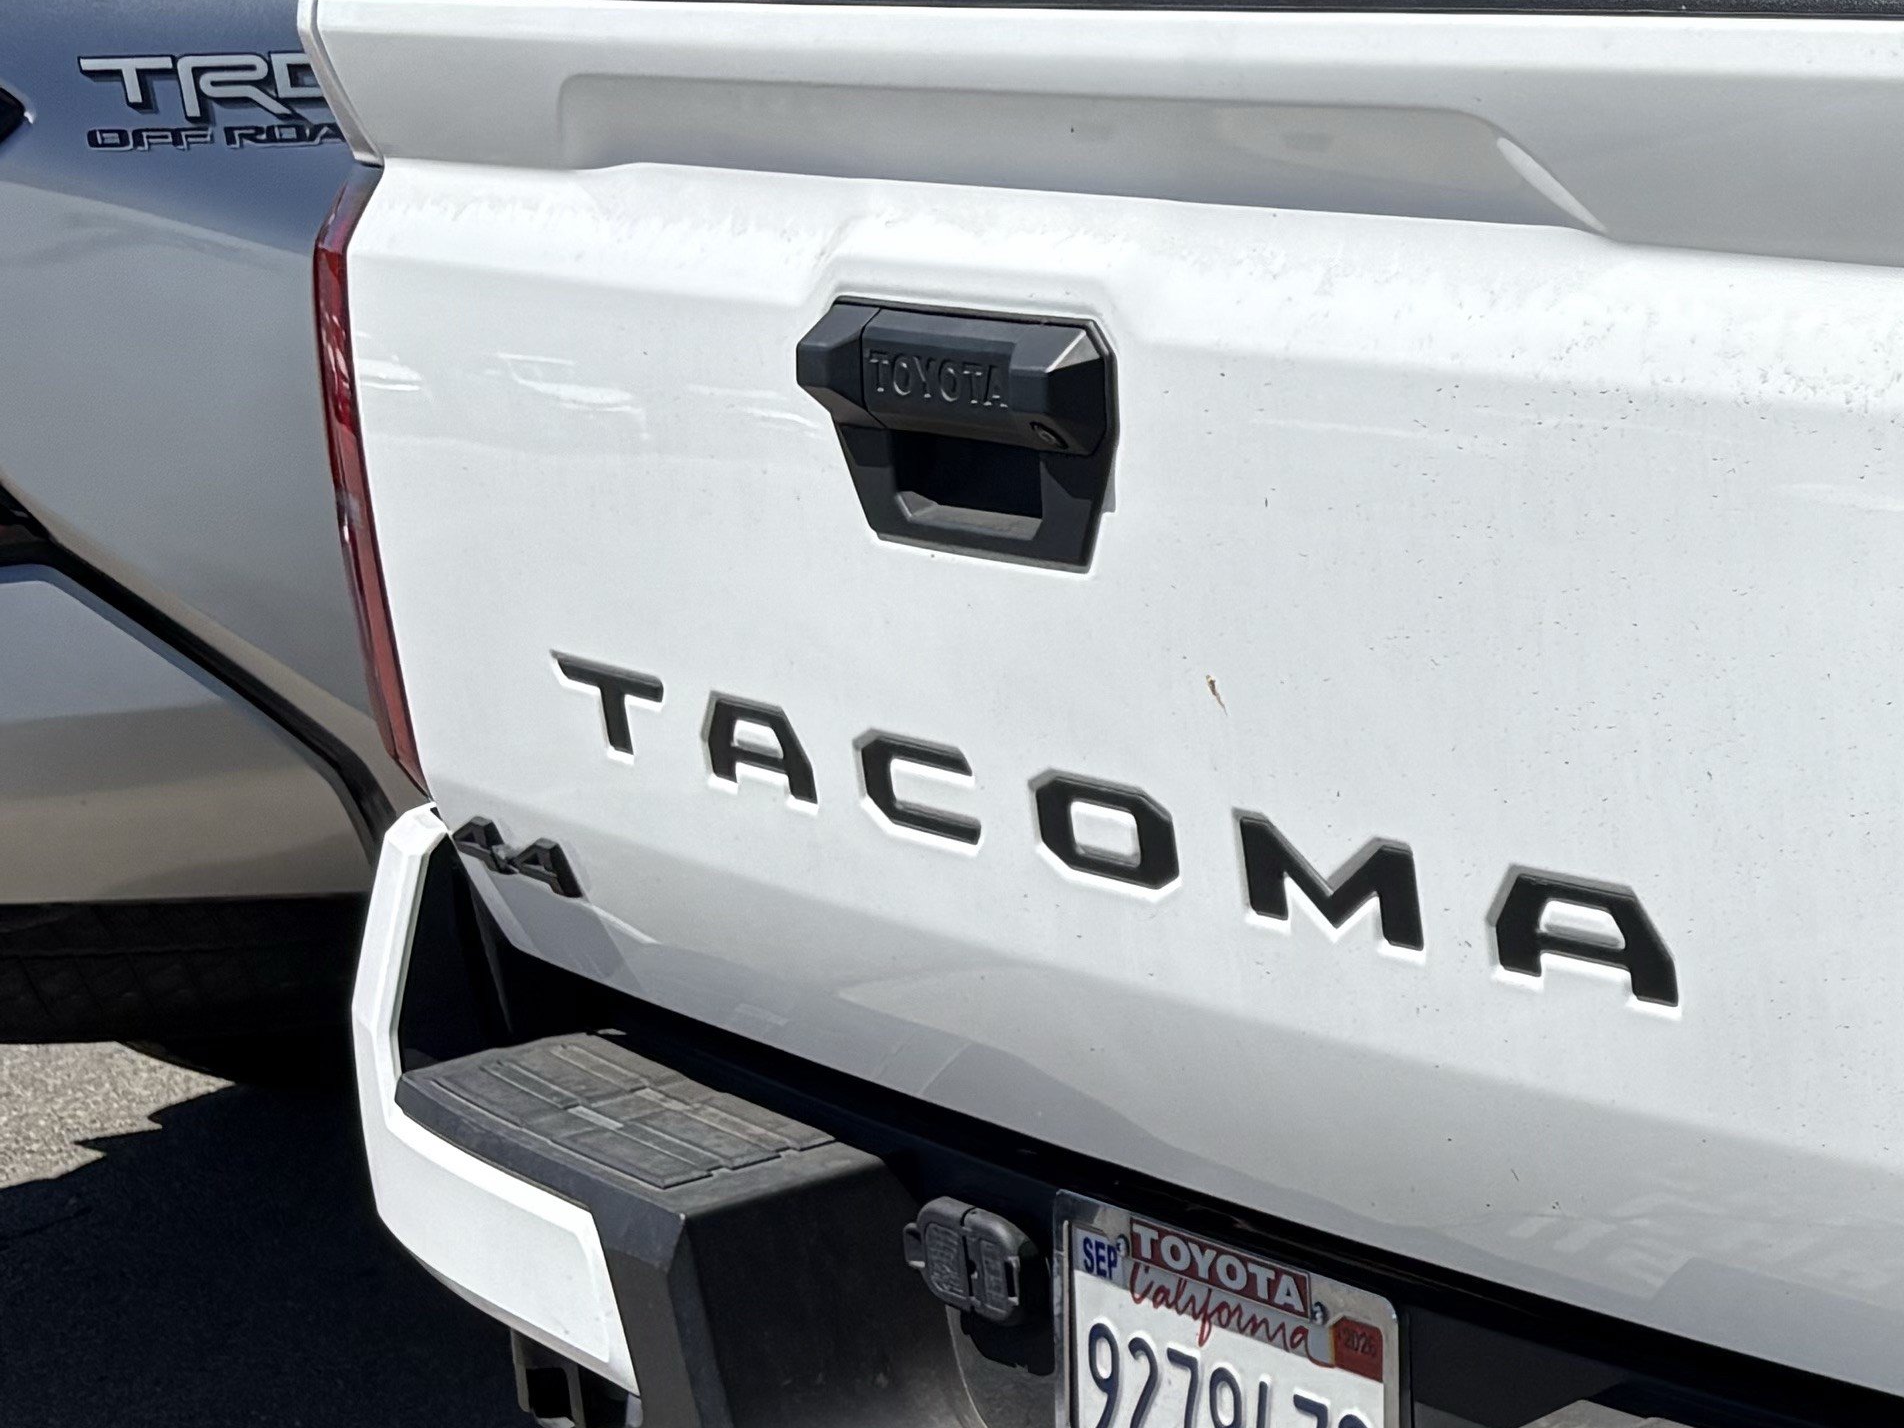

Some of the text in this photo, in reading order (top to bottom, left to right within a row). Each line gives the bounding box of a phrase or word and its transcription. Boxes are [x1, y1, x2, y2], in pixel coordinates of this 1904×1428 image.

[87, 122, 347, 152] OFF ROA
[866, 348, 1009, 409] TOYOTA
[549, 649, 1681, 1008] TACOMA
[1083, 1236, 1118, 1280] SEP
[1131, 1223, 1308, 1314] TOYOTA
[1130, 1261, 1335, 1369] California
